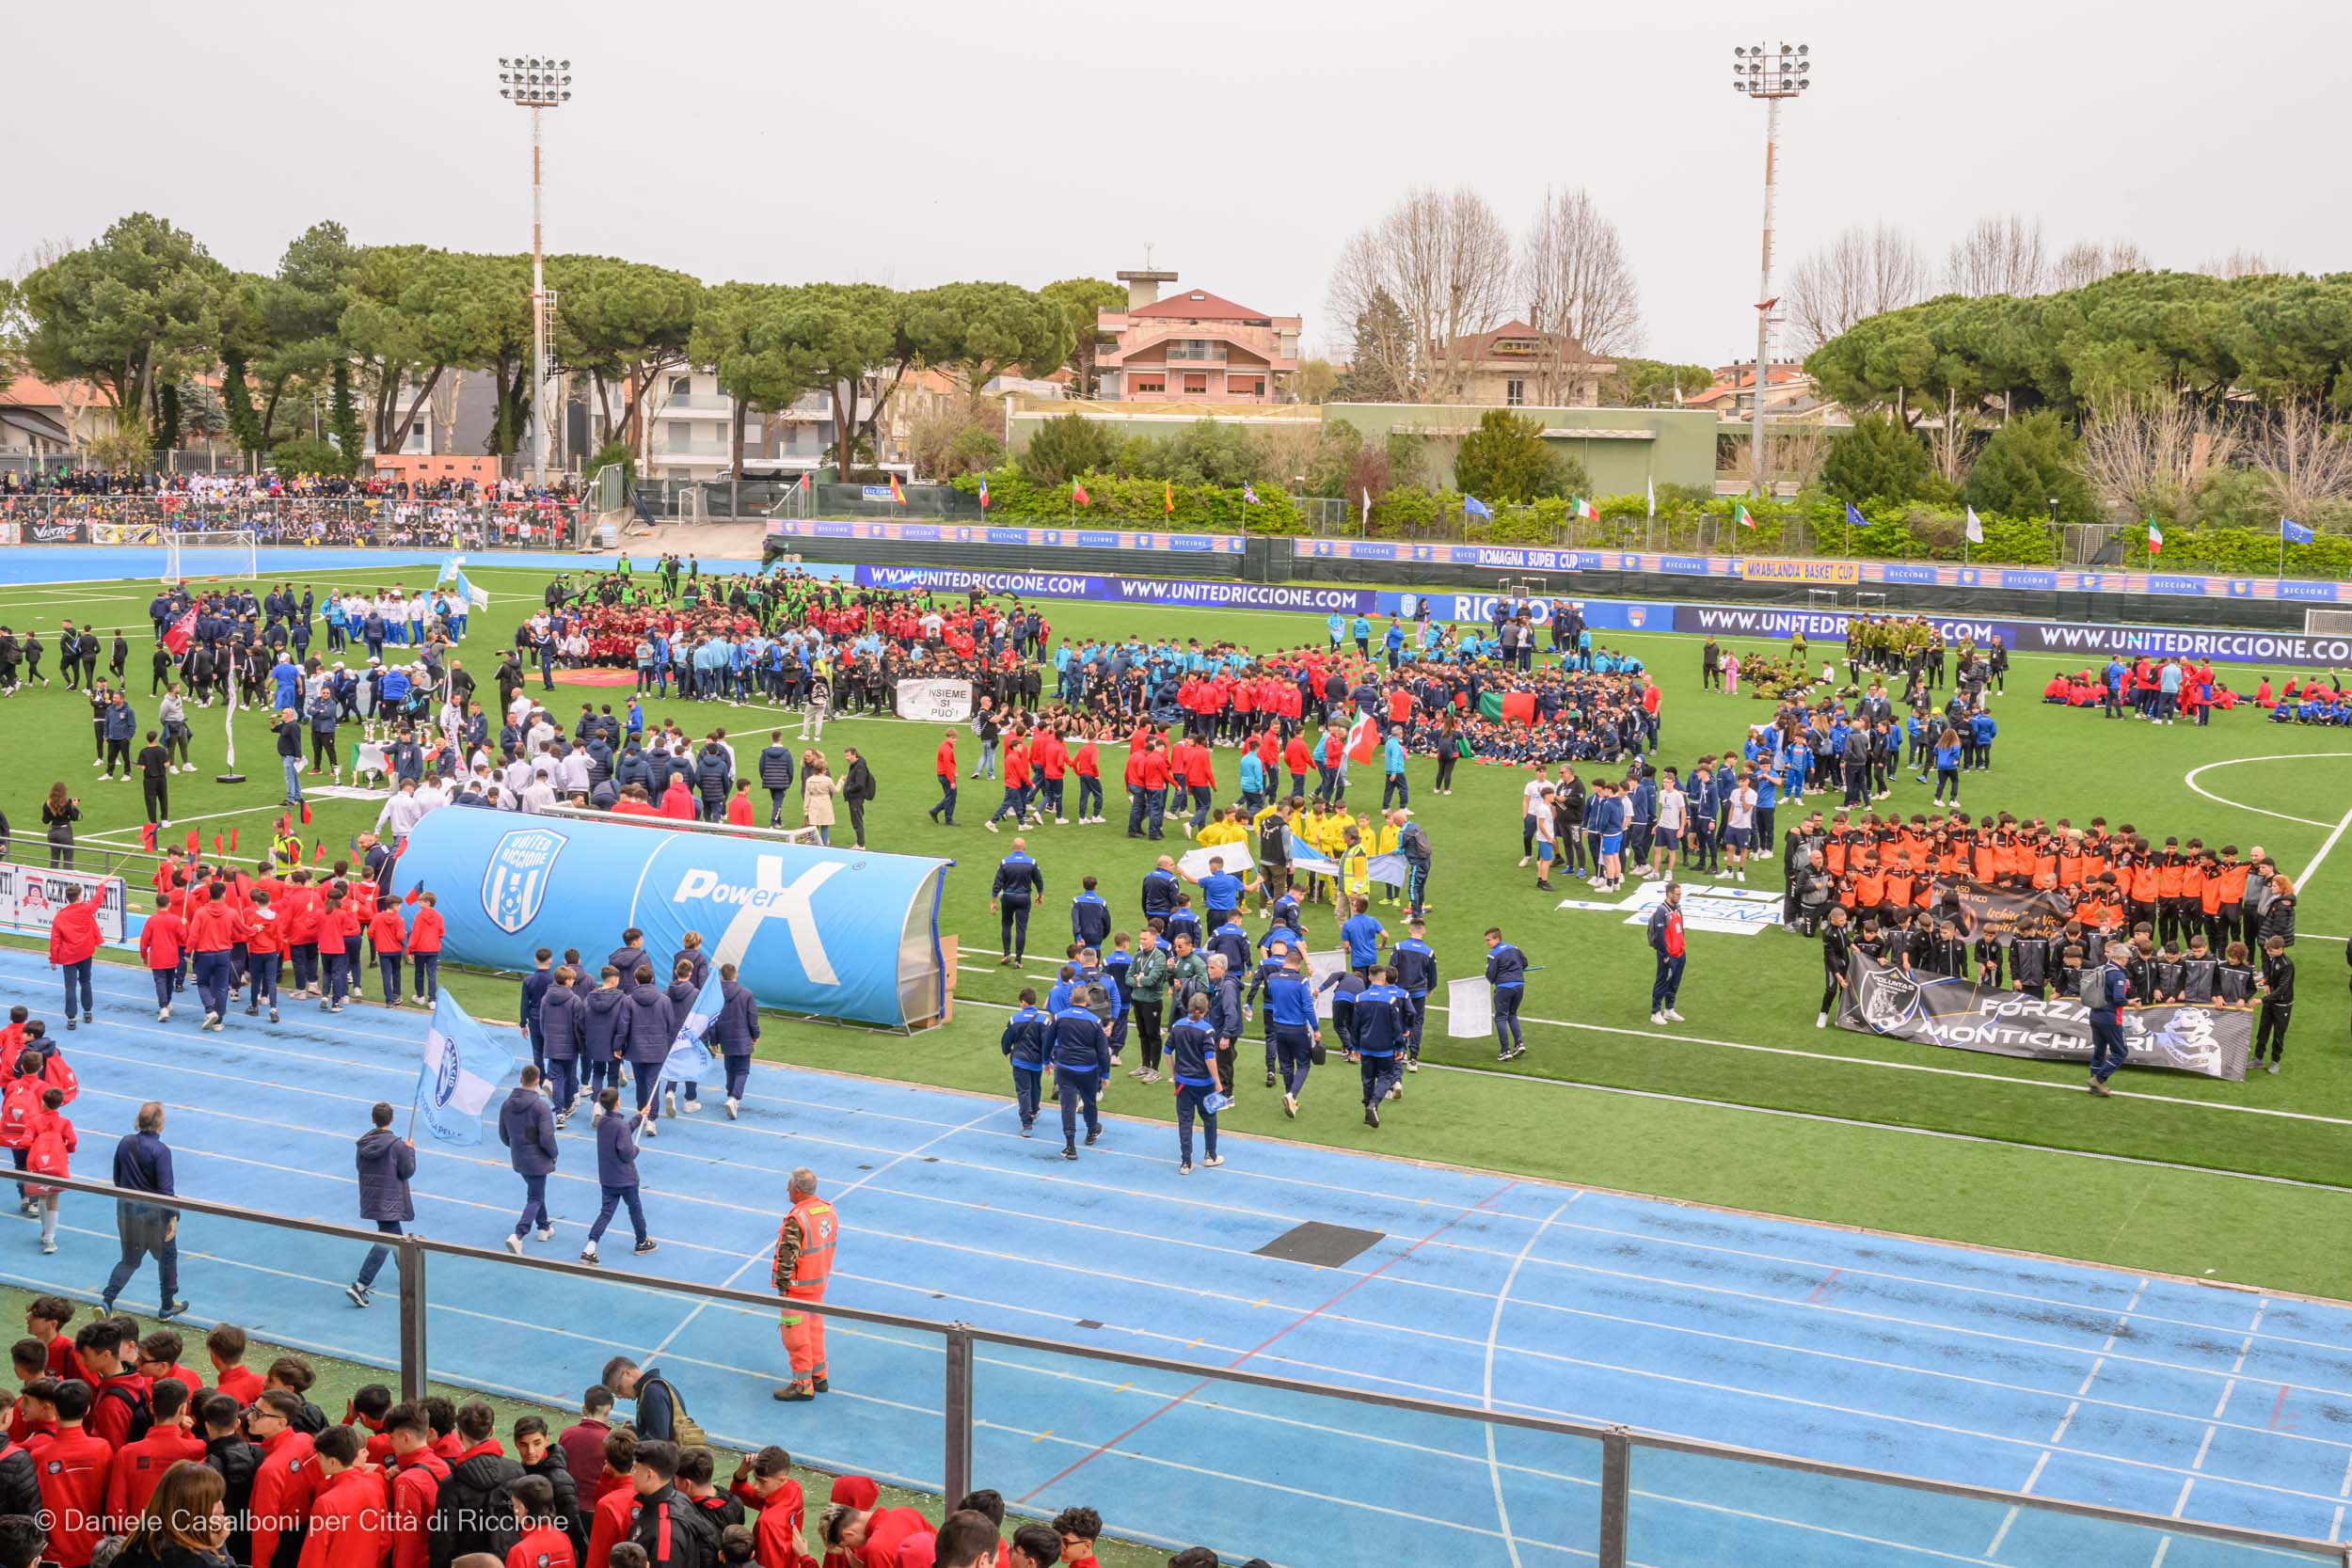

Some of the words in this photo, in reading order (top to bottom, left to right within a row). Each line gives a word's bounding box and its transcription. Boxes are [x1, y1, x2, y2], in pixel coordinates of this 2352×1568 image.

[1479, 548, 1524, 566] ROMAGNA
[1528, 551, 1555, 568] SUPER
[1560, 553, 1578, 570] CUP
[870, 567, 1086, 594] WWW.UNITEDRICCIONE.COM
[1747, 562, 1801, 578] MIRABILANDIA
[1804, 565, 1834, 579] BASKET
[1837, 567, 1853, 580] CUP
[1120, 580, 1357, 609] WWW.UNITEDRICCIONE.COM
[2040, 626, 2352, 661] WWW.UNITEDRICCIONE.CO
[941, 699, 950, 707] SI
[511, 834, 552, 851] UNITED
[501, 848, 549, 869] RICCIONE
[1954, 884, 1971, 894] ASD
[1970, 894, 1988, 903] VICO
[1872, 974, 1915, 990] VOLUNTAS
[1915, 1021, 2154, 1052] MONTICHIRI
